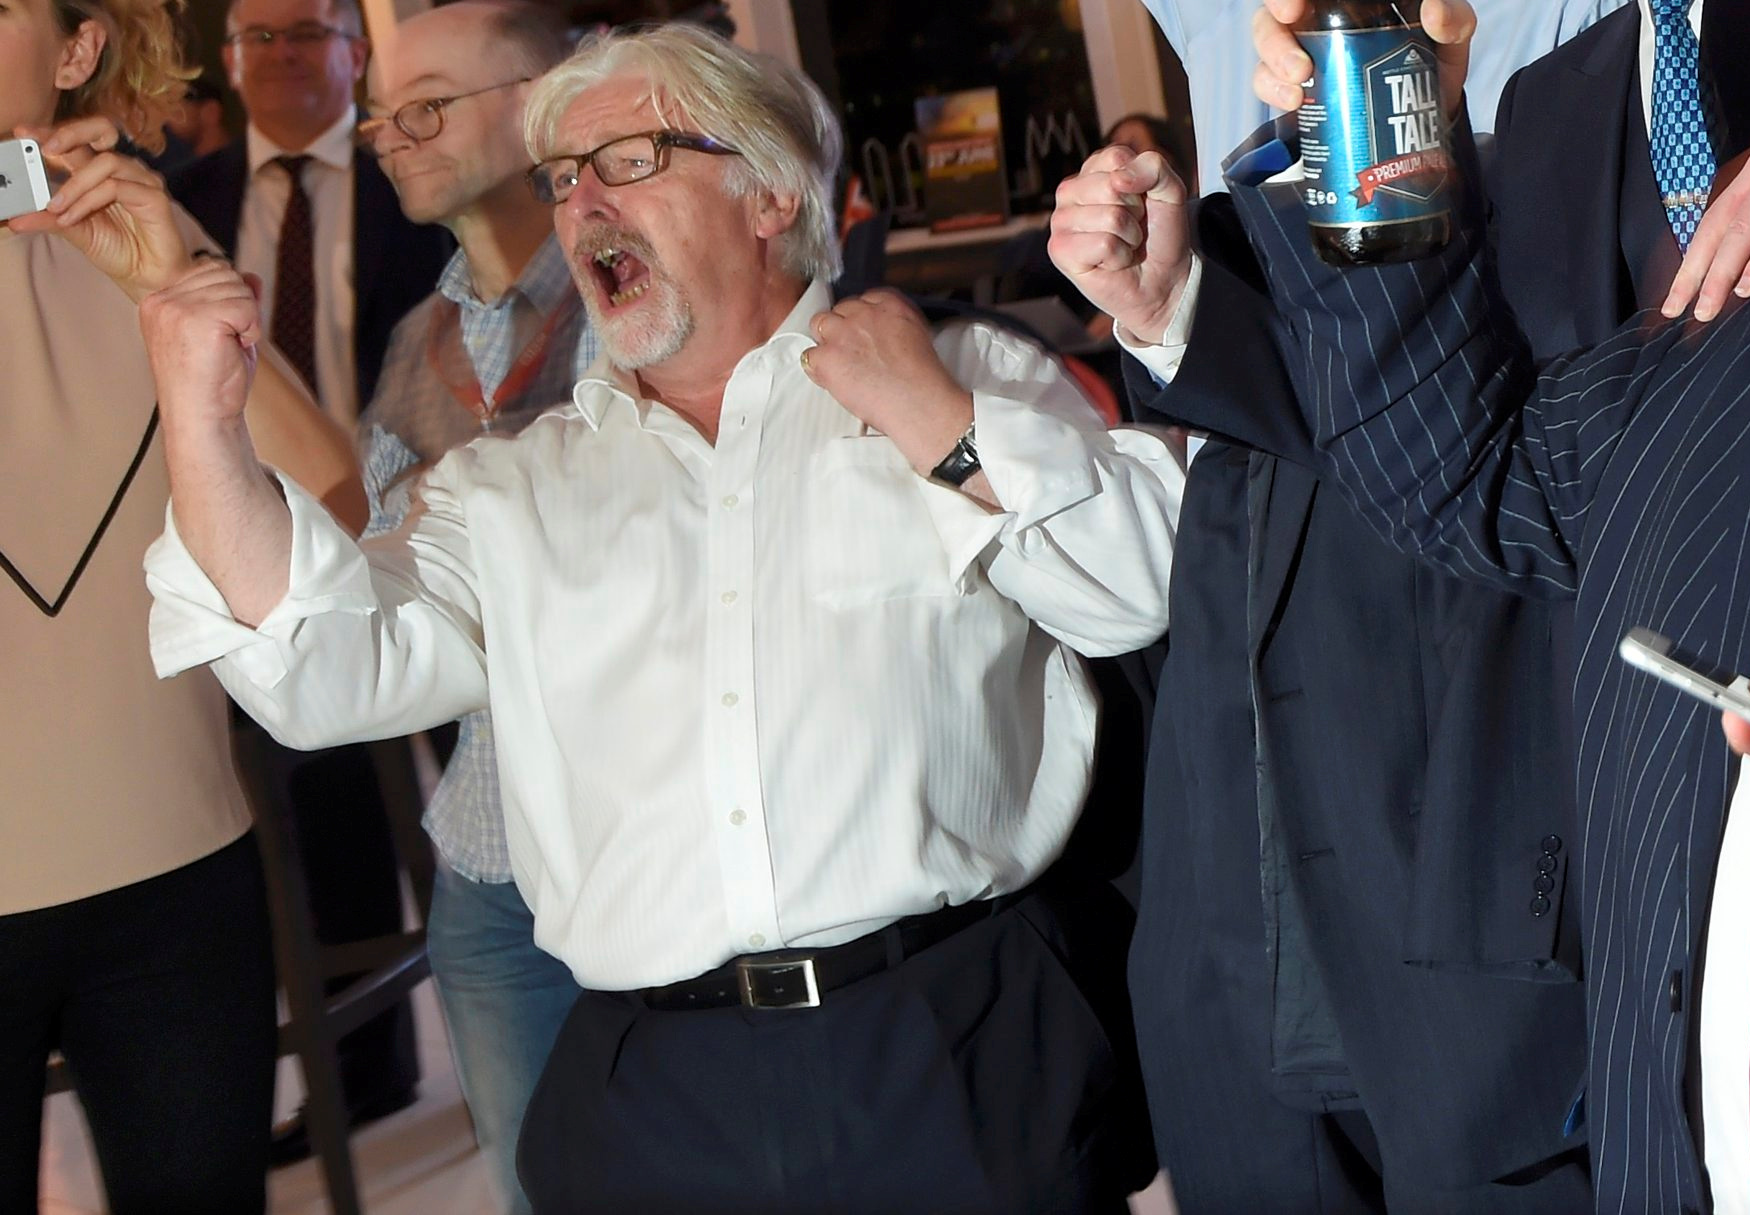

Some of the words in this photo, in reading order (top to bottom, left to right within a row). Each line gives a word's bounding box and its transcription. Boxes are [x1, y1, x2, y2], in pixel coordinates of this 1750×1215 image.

[1384, 71, 1437, 114] TALL
[1387, 110, 1440, 155] TALE
[1373, 156, 1422, 182] PREMIUM
